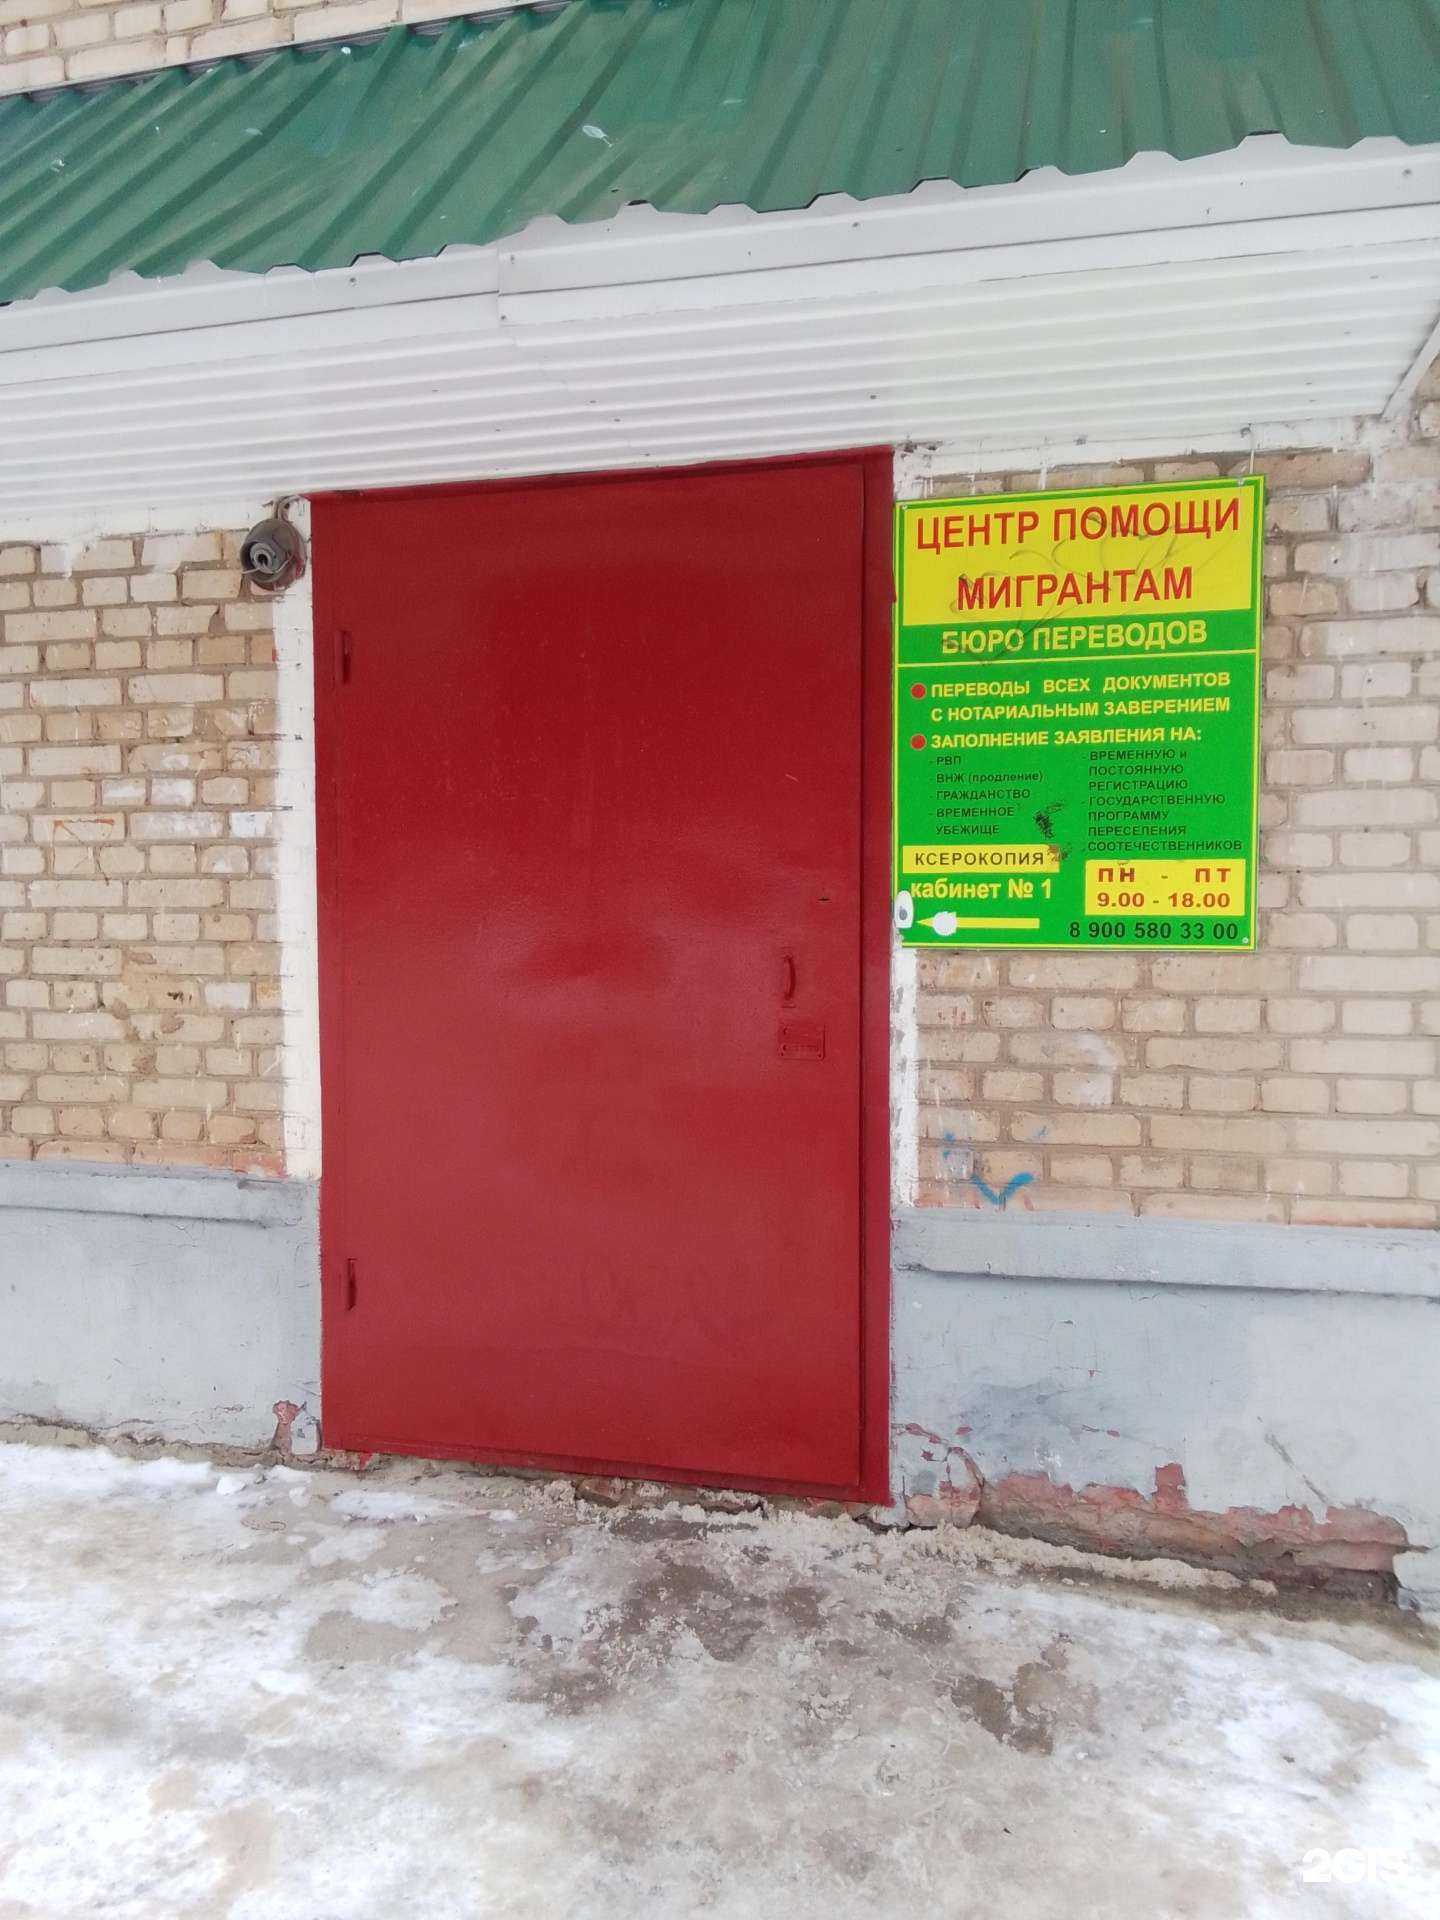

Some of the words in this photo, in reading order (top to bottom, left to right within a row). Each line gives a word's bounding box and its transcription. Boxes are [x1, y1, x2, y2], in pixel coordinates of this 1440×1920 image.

[917, 510, 1039, 555] ЦЕНТР
[1053, 498, 1239, 542] ПОМОЩИ
[956, 567, 1193, 611] МИГРАНТАМ
[942, 630, 1024, 654] БЮРО
[1033, 620, 1207, 651] ПЕРЕВОДОВ
[931, 681, 1030, 698] ПЕРЕВОДЫ
[1043, 678, 1091, 694] ВСЕХ
[1103, 672, 1231, 692] ДОКУМЕНТОВ
[931, 708, 943, 722] С
[948, 702, 1098, 721] НОТАРИАЛЬНЫМ
[1104, 697, 1230, 715] ЗАВЕРЕНИЕМ
[931, 731, 1049, 749] ЗАПОЛНЕНИЕ
[1054, 728, 1165, 745] ЗАЯВЛЕНИЯ
[1170, 727, 1202, 742] НА:
[936, 755, 962, 766] РВП
[1089, 749, 1176, 761] ВРЕМЕННУЮ
[936, 773, 965, 784] ВНЖ
[968, 769, 1044, 785] (продление)
[1088, 765, 1184, 776] ПОСТОЯННУЮ
[1088, 779, 1189, 791] РЕГИСТРАЦИЮ
[936, 788, 1031, 801] ГРАЖДАНСТВО
[1089, 794, 1226, 806] ГОСУДАРСТВЕННУЮ
[936, 806, 1015, 818] ВРЕМЕННОЕ
[1088, 811, 1169, 822] ПРОГРАММУ
[935, 824, 1000, 836] УБЕЖИЩЕ
[1087, 825, 1187, 837] ПЕРЕСЕЛЕНИЯ
[1087, 840, 1243, 852] СООТЕЧЕСТВЕННИКОВ
[915, 852, 1044, 866] КСЕРОКОПИЯ
[1098, 867, 1135, 883] ПН
[1195, 867, 1231, 883] ПТ
[910, 878, 1001, 899] кабинет
[1041, 878, 1052, 899] 1
[1097, 892, 1145, 908] 9.00
[1168, 892, 1231, 908] 18.00
[1069, 921, 1081, 938] 8
[1088, 921, 1126, 938] 900
[1134, 922, 1172, 939] 580
[1180, 922, 1205, 940] 33
[1213, 922, 1239, 940] 00
